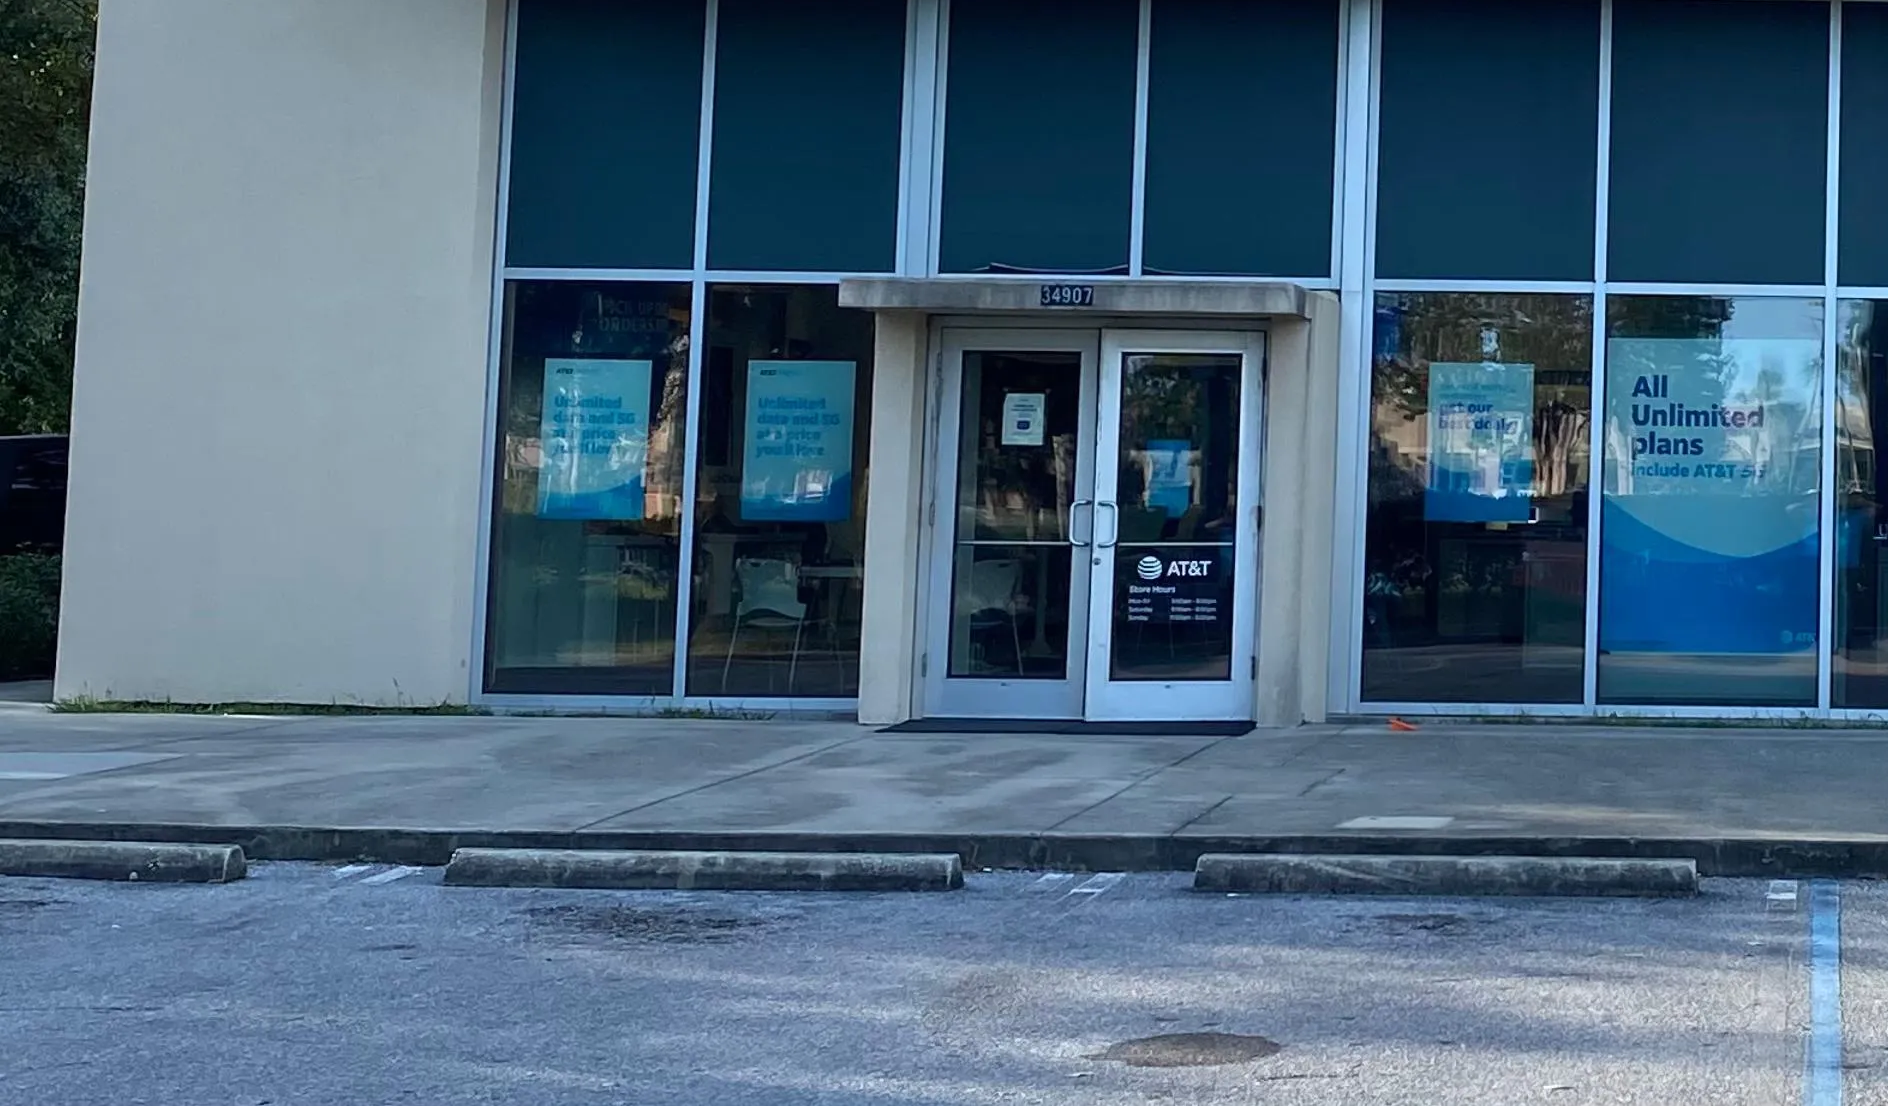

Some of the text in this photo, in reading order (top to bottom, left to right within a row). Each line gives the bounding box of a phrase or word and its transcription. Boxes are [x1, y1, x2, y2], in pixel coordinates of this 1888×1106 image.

[1041, 286, 1092, 304] 34907
[1631, 374, 1668, 398] All
[554, 395, 622, 408] Unmited
[758, 396, 827, 409] Unlimited
[1467, 403, 1494, 414] our
[1631, 402, 1765, 428] Unlimited
[1631, 431, 1704, 461] plans
[1631, 462, 1690, 478] include
[1693, 463, 1737, 479] AT&T
[1166, 560, 1213, 577] AT&T
[1129, 585, 1176, 594] Store Hours
